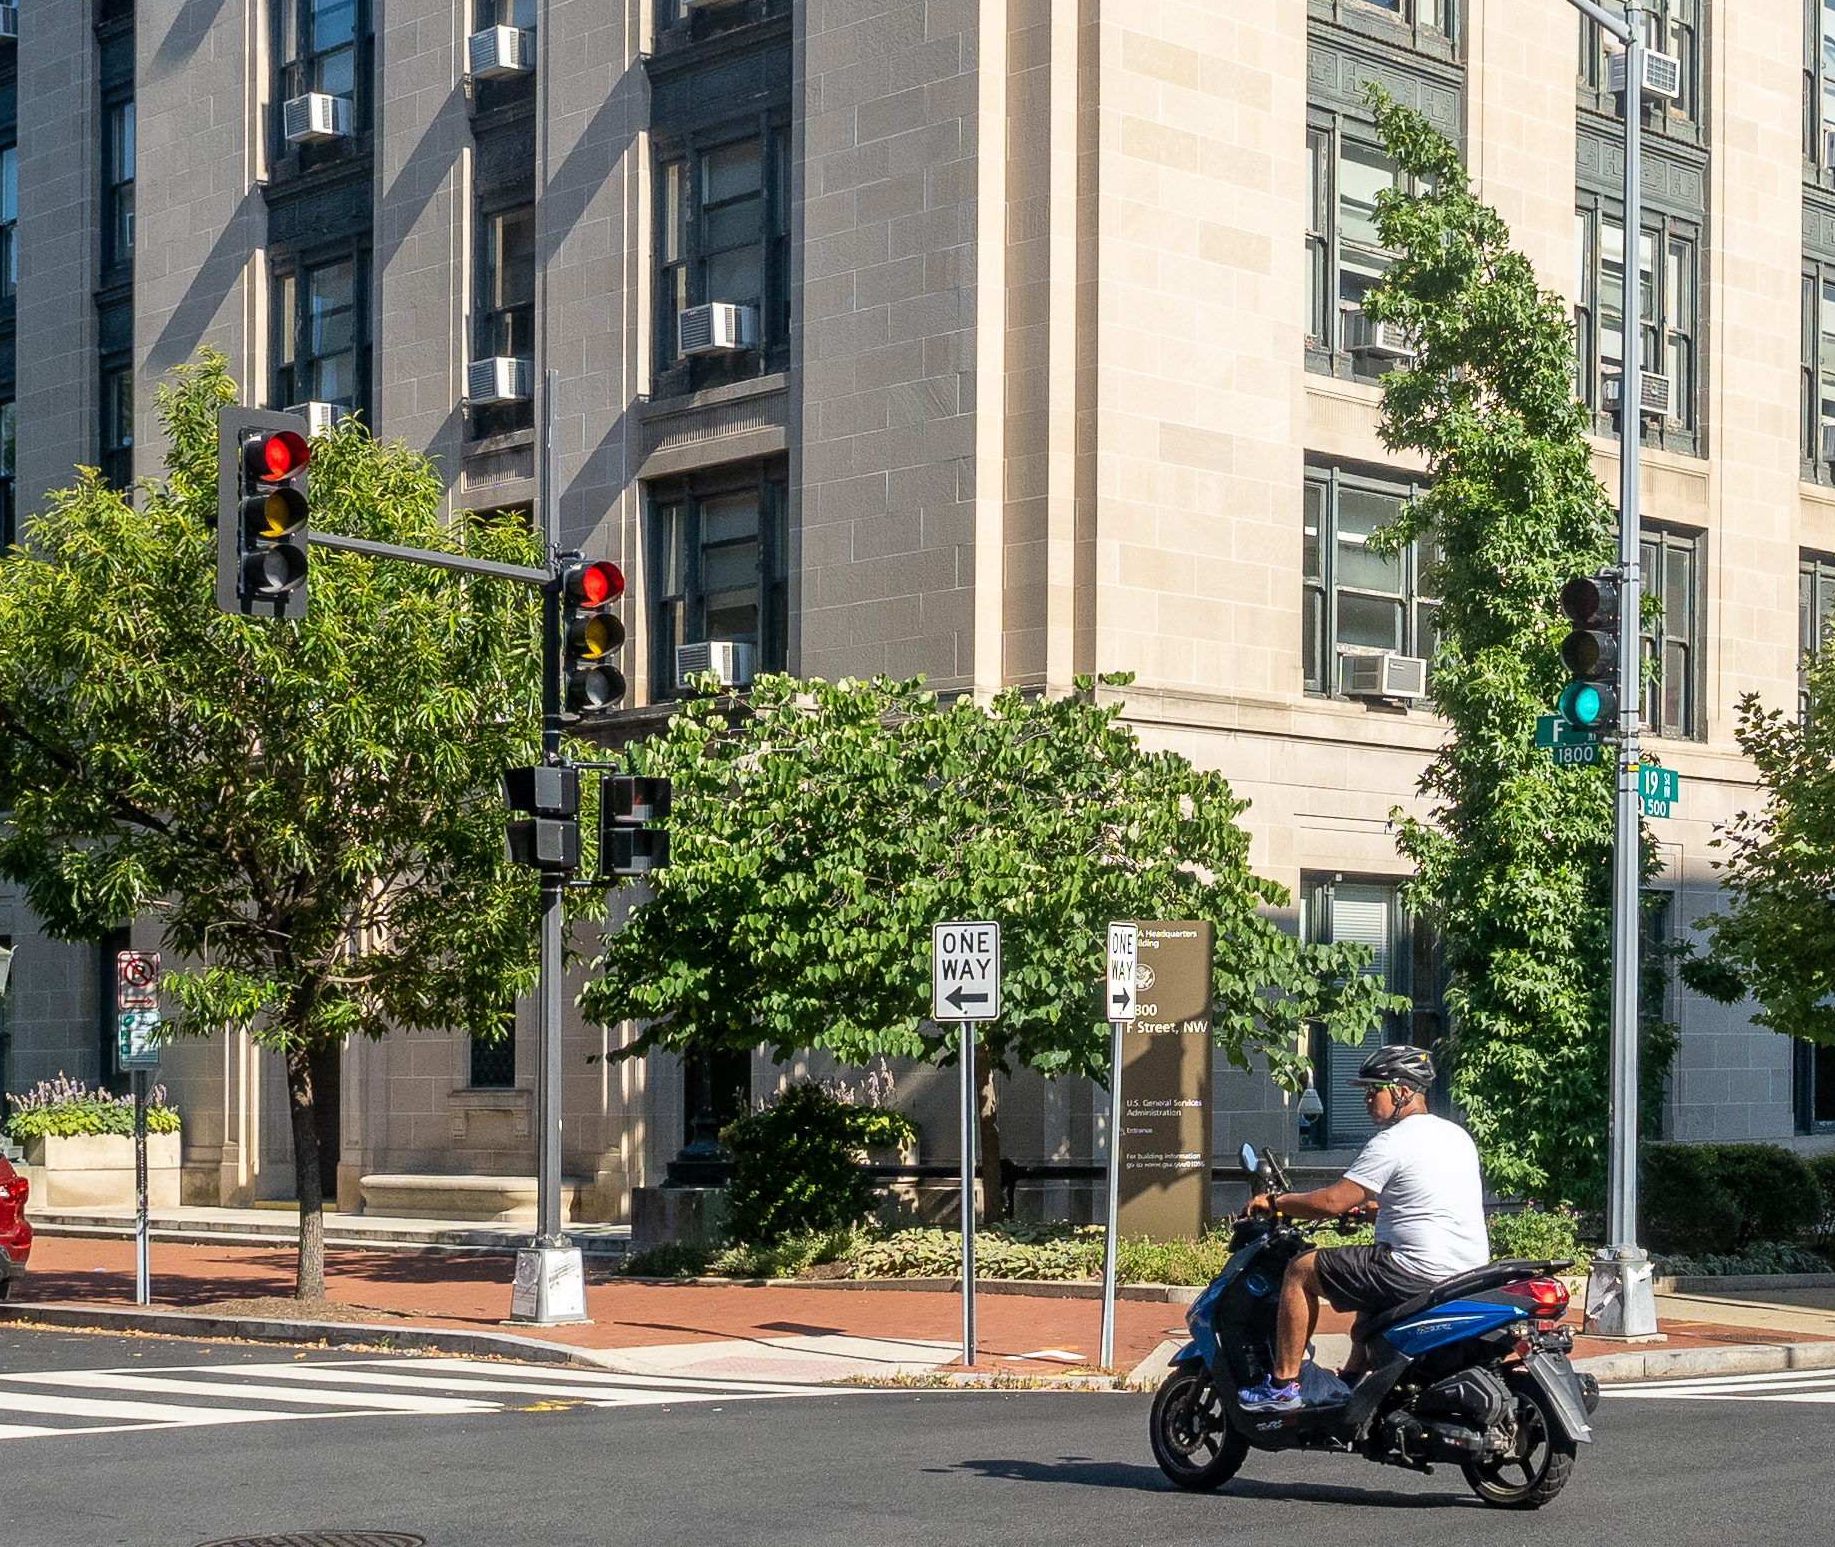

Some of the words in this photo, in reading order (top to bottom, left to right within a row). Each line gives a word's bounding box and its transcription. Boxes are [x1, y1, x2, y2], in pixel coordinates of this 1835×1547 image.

[1552, 719, 1566, 743] F
[1558, 746, 1594, 763] 1800
[1644, 770, 1658, 795] 19
[1647, 799, 1667, 817] 500
[942, 931, 990, 954] ONE
[1145, 929, 1198, 939] Headquarters
[1112, 932, 1133, 955] ONE
[941, 958, 992, 981] WAY
[1111, 959, 1134, 982] WAY
[1137, 1020, 1179, 1035] Street,
[1183, 1020, 1208, 1033] NW
[1126, 1099, 1141, 1107] U.S.
[1142, 1098, 1172, 1107] General
[1173, 1098, 1203, 1107] Services
[1126, 1108, 1182, 1117] Administration
[1137, 1152, 1164, 1161] building
[1164, 1152, 1201, 1160] information
